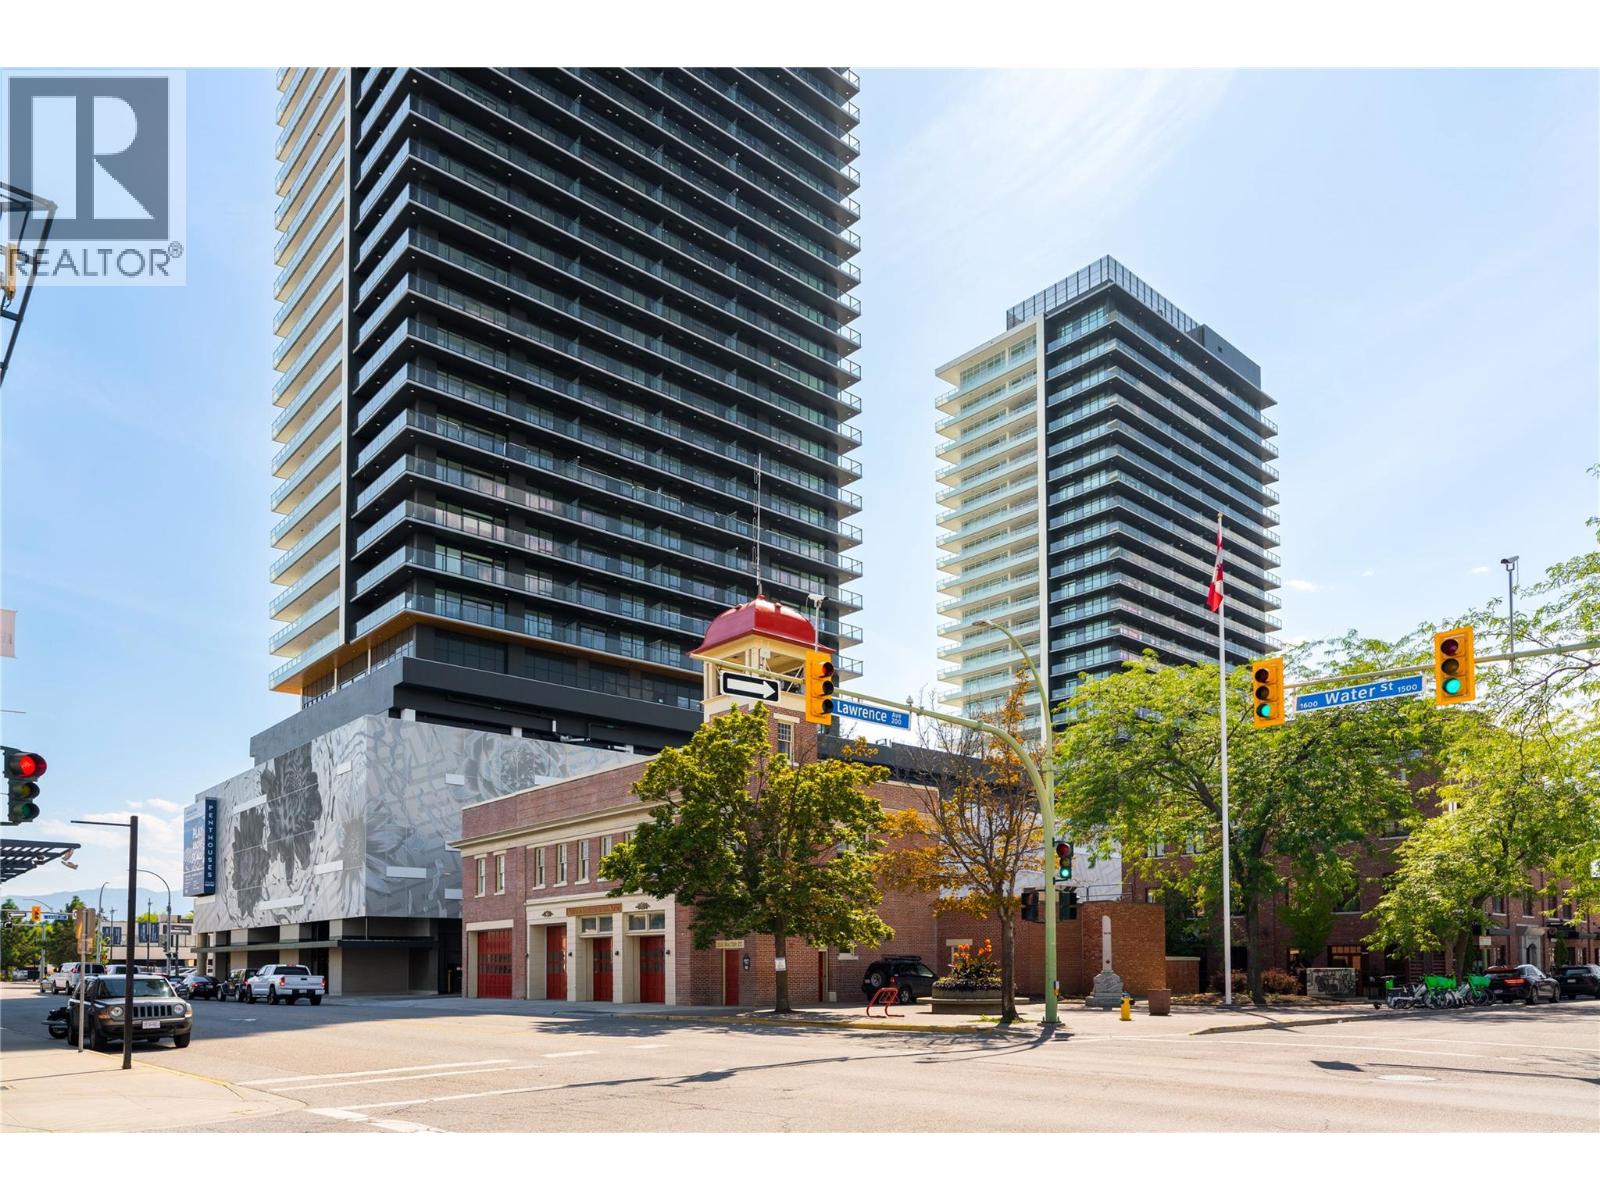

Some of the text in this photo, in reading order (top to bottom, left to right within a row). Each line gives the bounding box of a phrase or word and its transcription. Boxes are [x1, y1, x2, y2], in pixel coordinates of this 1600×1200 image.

[1300, 682, 1418, 710] 1600 Water St 1500
[837, 700, 888, 722] Lawrence
